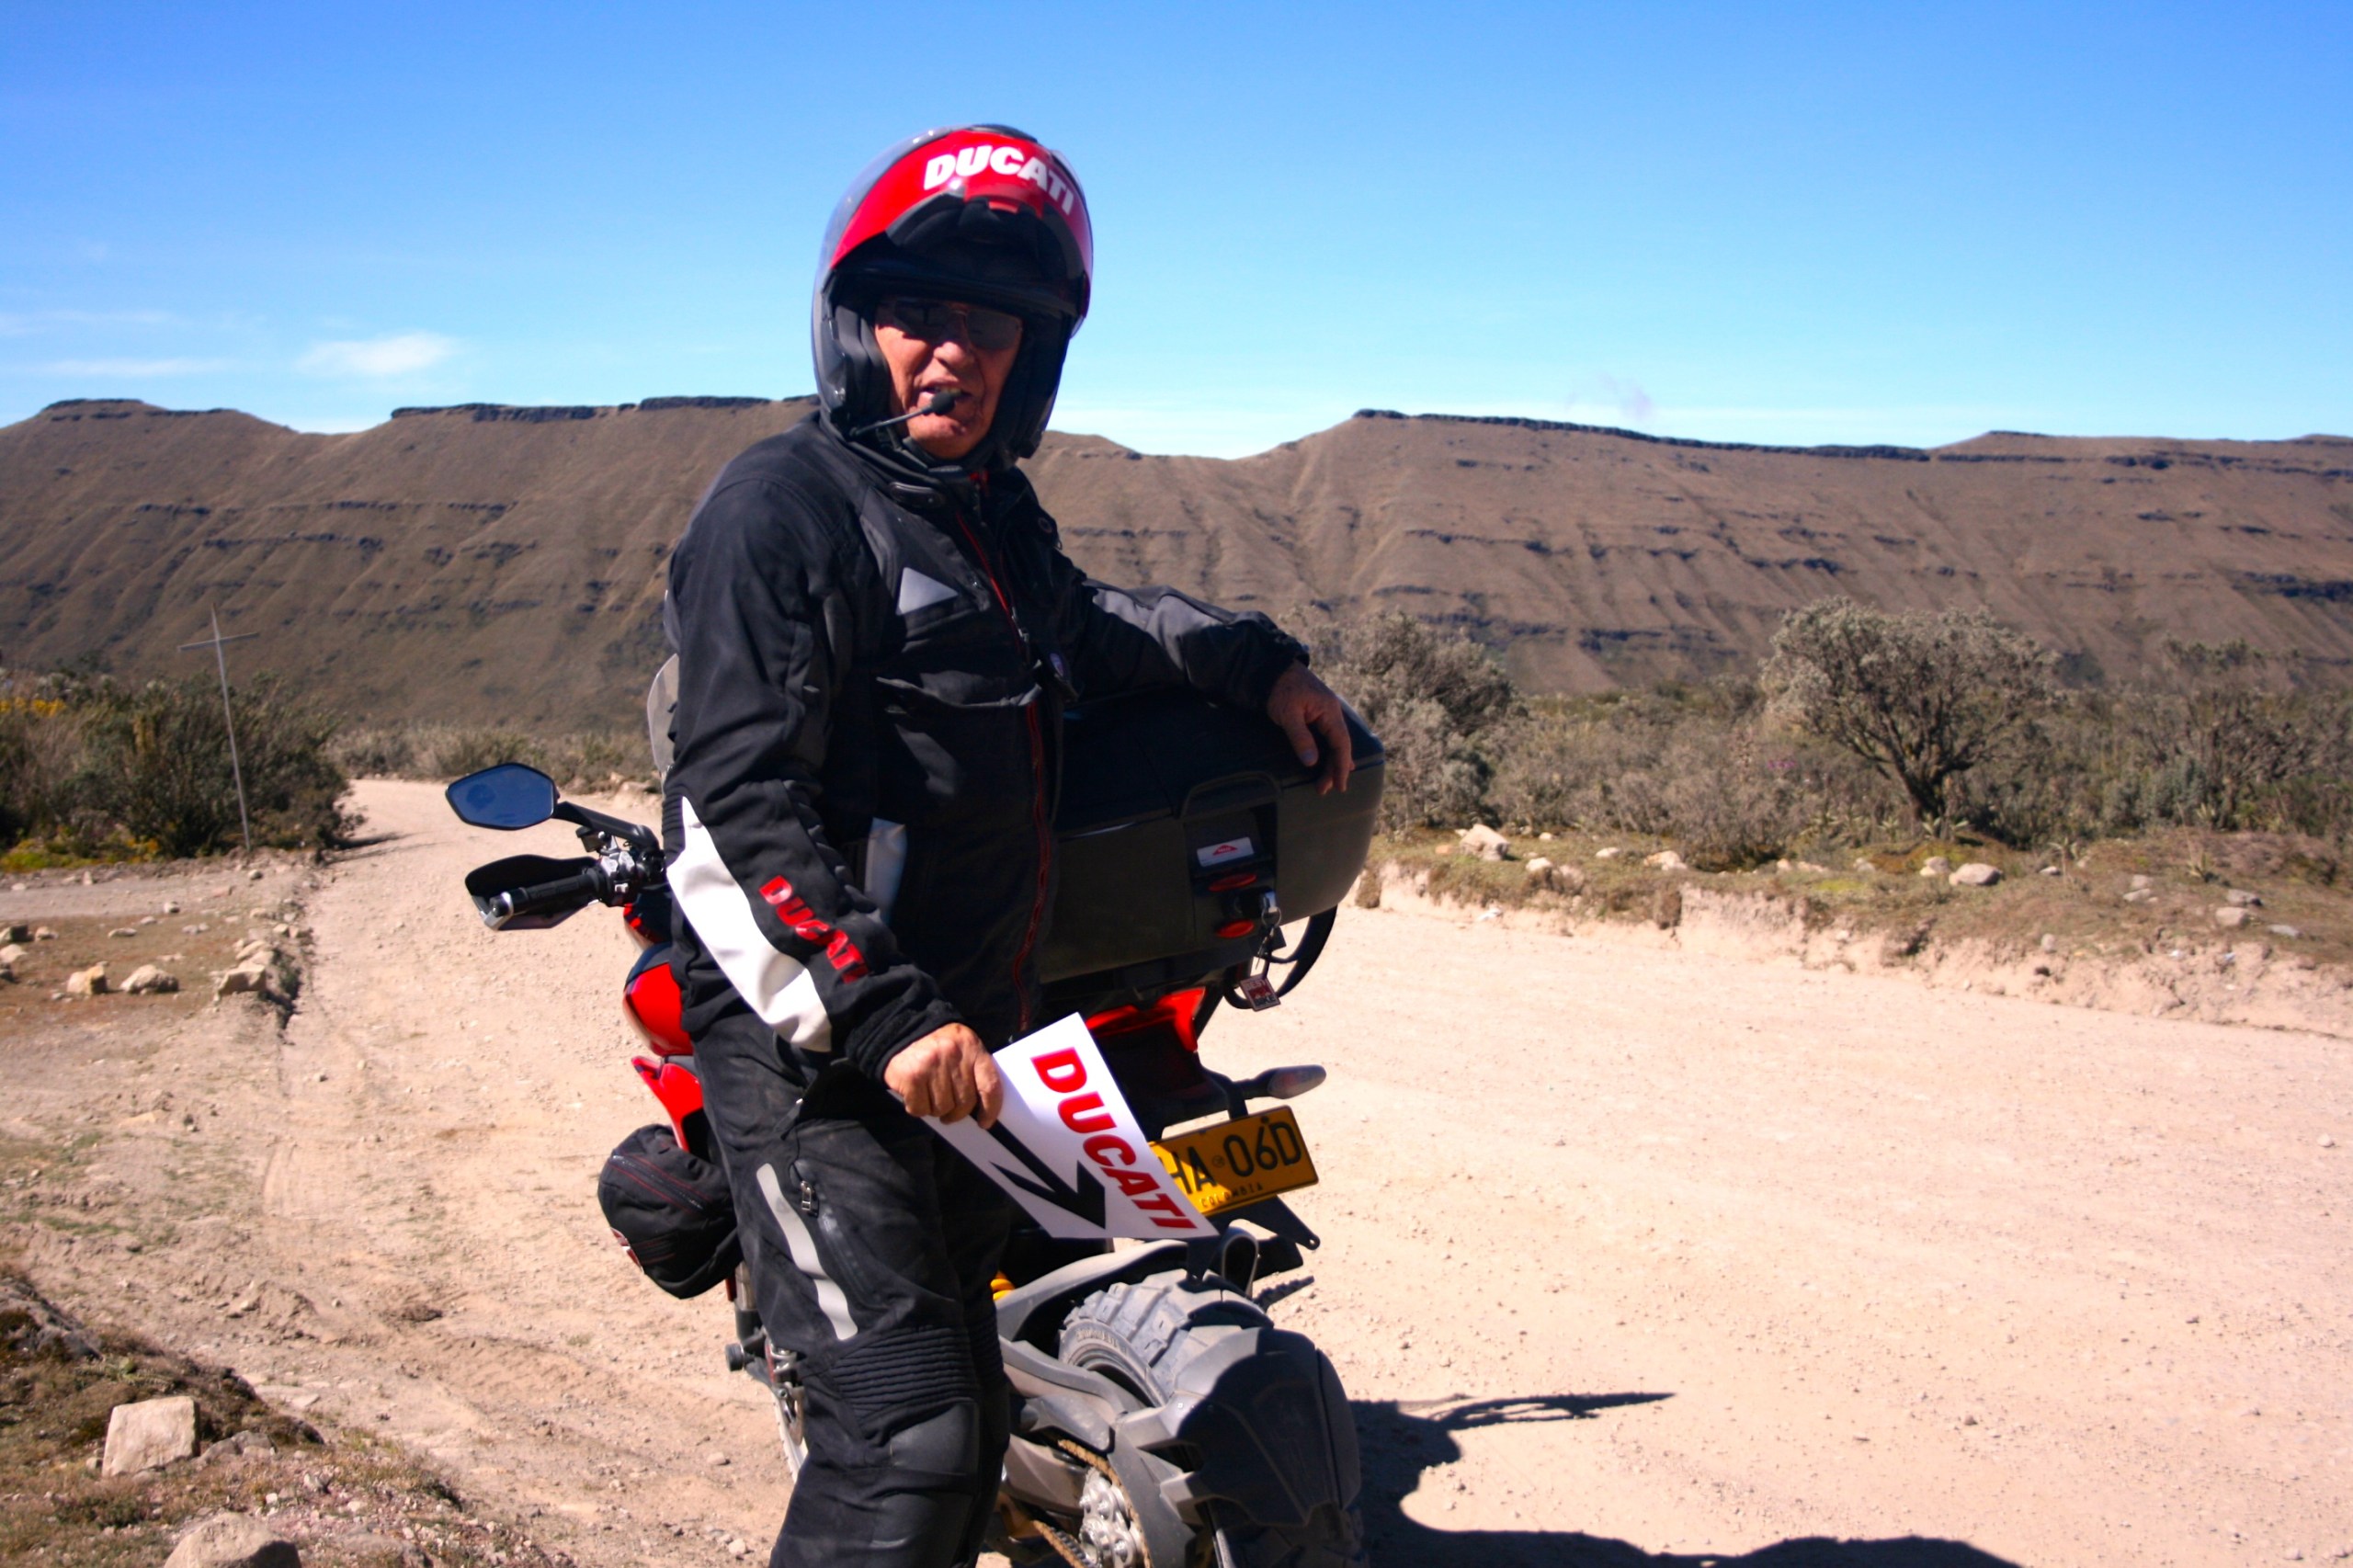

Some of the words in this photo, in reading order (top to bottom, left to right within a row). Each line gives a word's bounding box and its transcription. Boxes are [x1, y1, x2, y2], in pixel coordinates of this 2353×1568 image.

[924, 144, 1074, 216] DUCATI
[758, 874, 870, 984] DUCATI
[1029, 1046, 1199, 1230] DUCATI
